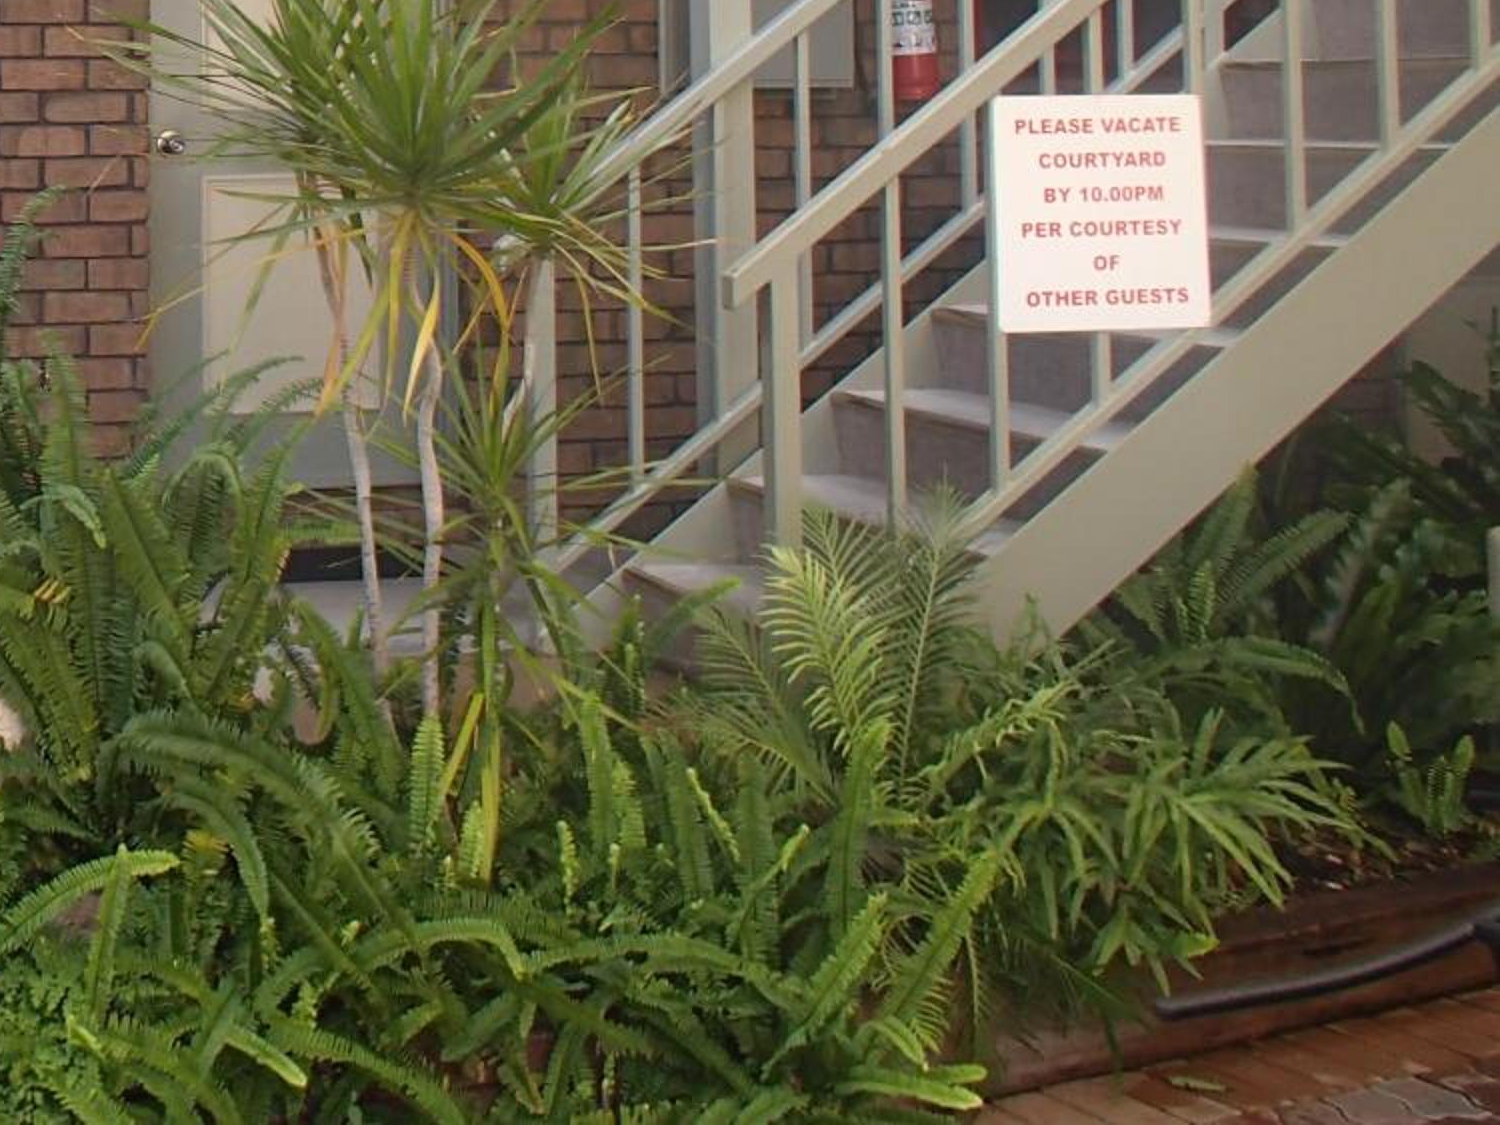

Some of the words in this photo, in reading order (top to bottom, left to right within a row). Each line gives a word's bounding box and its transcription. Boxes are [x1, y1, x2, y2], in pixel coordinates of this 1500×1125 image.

[1013, 117, 1094, 135] PLEASE
[1100, 116, 1182, 134] VACATE
[1038, 150, 1167, 170] COURTYARD
[1043, 186, 1072, 204] BY
[1079, 184, 1165, 203] 10.00PM
[1020, 221, 1063, 239] PER
[1068, 218, 1182, 238] COURTESY
[1092, 254, 1121, 272] OF
[1025, 289, 1099, 308] OTHER
[1104, 286, 1190, 306] GUESTS
